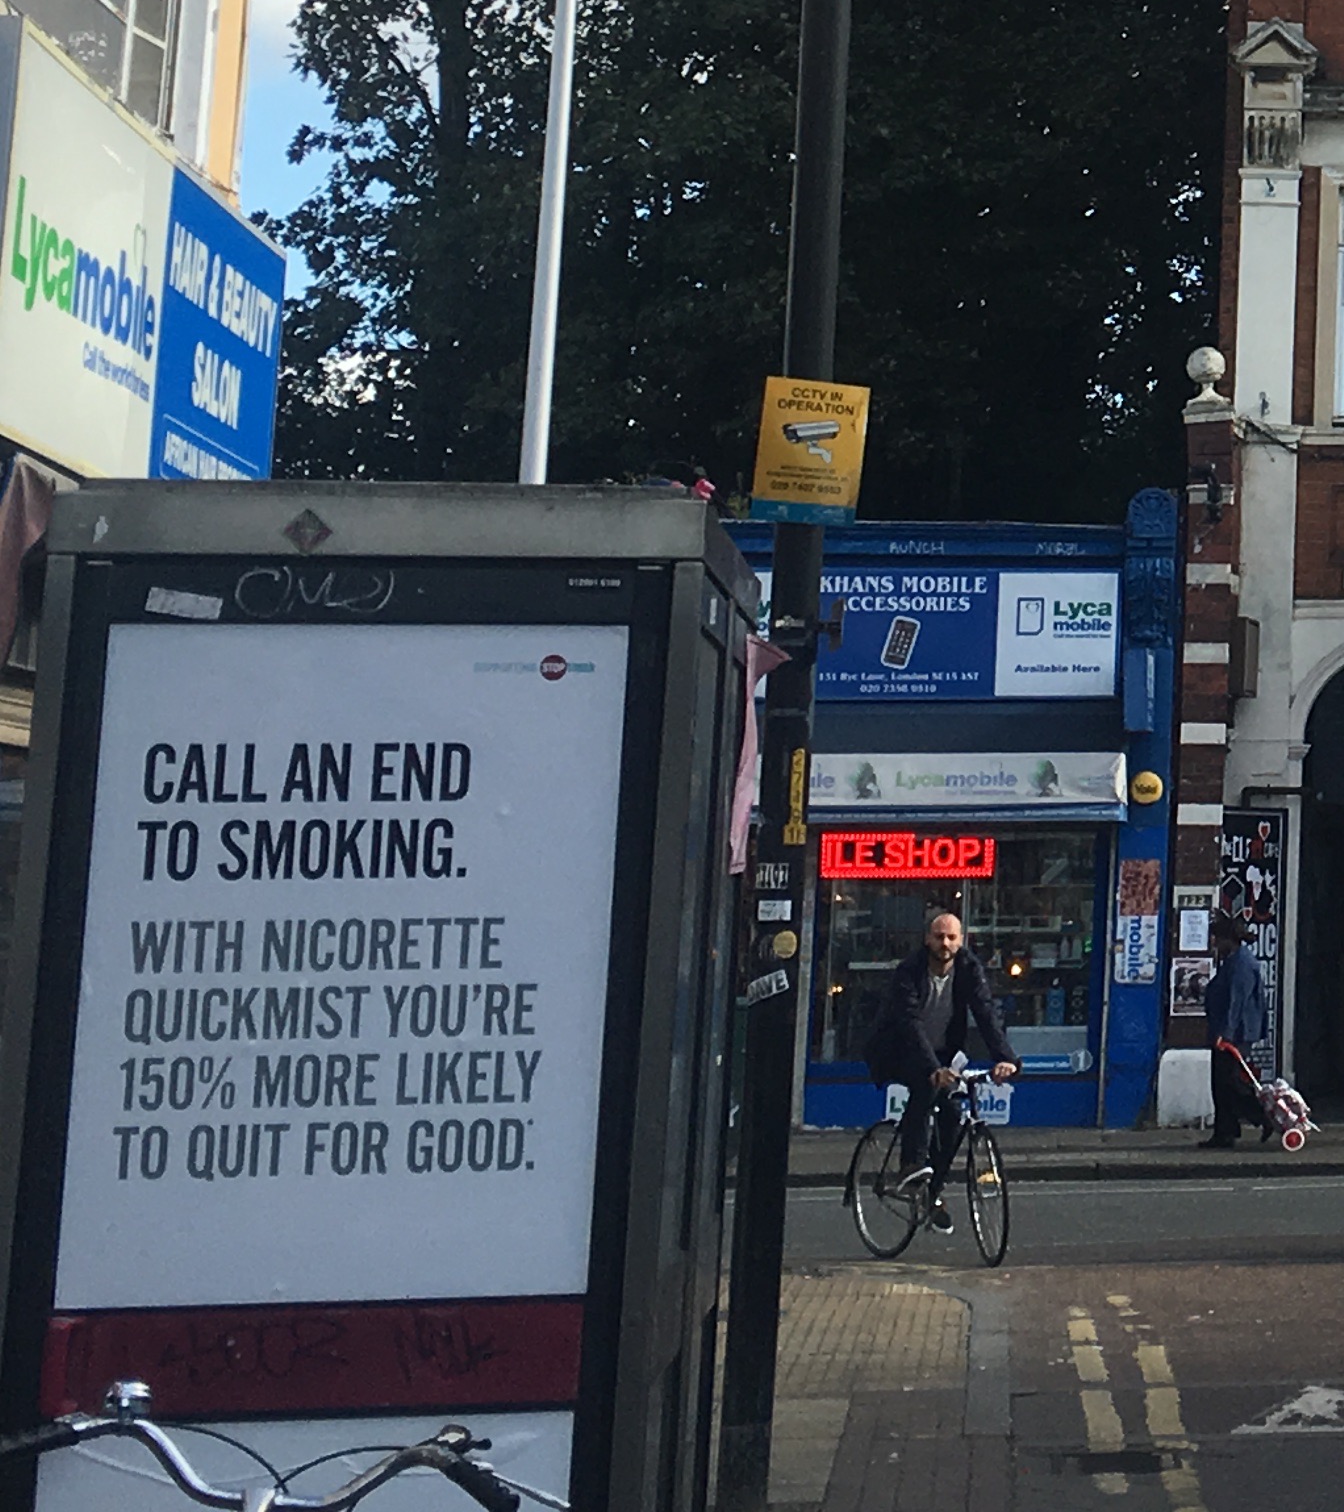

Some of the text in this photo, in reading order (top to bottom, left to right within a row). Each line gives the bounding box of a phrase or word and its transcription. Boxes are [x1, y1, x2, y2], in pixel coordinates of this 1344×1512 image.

[11, 175, 156, 362] Lycamobile
[169, 221, 278, 358] HAIR & BEAUTY
[192, 341, 242, 430] SALON
[777, 398, 855, 416] OPERATION
[791, 387, 844, 402] CCTV IN
[820, 574, 988, 595] KHANS MOBILE
[843, 595, 971, 613] CCESSORIES
[1053, 600, 1113, 620] Lyca
[1053, 618, 1113, 632] mobile
[1072, 663, 1101, 673] Here
[143, 742, 472, 805] CALL AN END
[896, 768, 1018, 792] Lycamobile
[137, 818, 468, 881] TO SMOKING.
[884, 838, 982, 868] SHOP
[131, 916, 506, 975] WITH NICORETTE
[1126, 916, 1143, 980] mobile
[124, 982, 539, 1047] QUICKMIST YOU'RE
[119, 1050, 543, 1111] 150% MORE LIKELY
[113, 1125, 169, 1181] TO
[187, 1123, 291, 1183] QUIT
[304, 1121, 390, 1176] FOR
